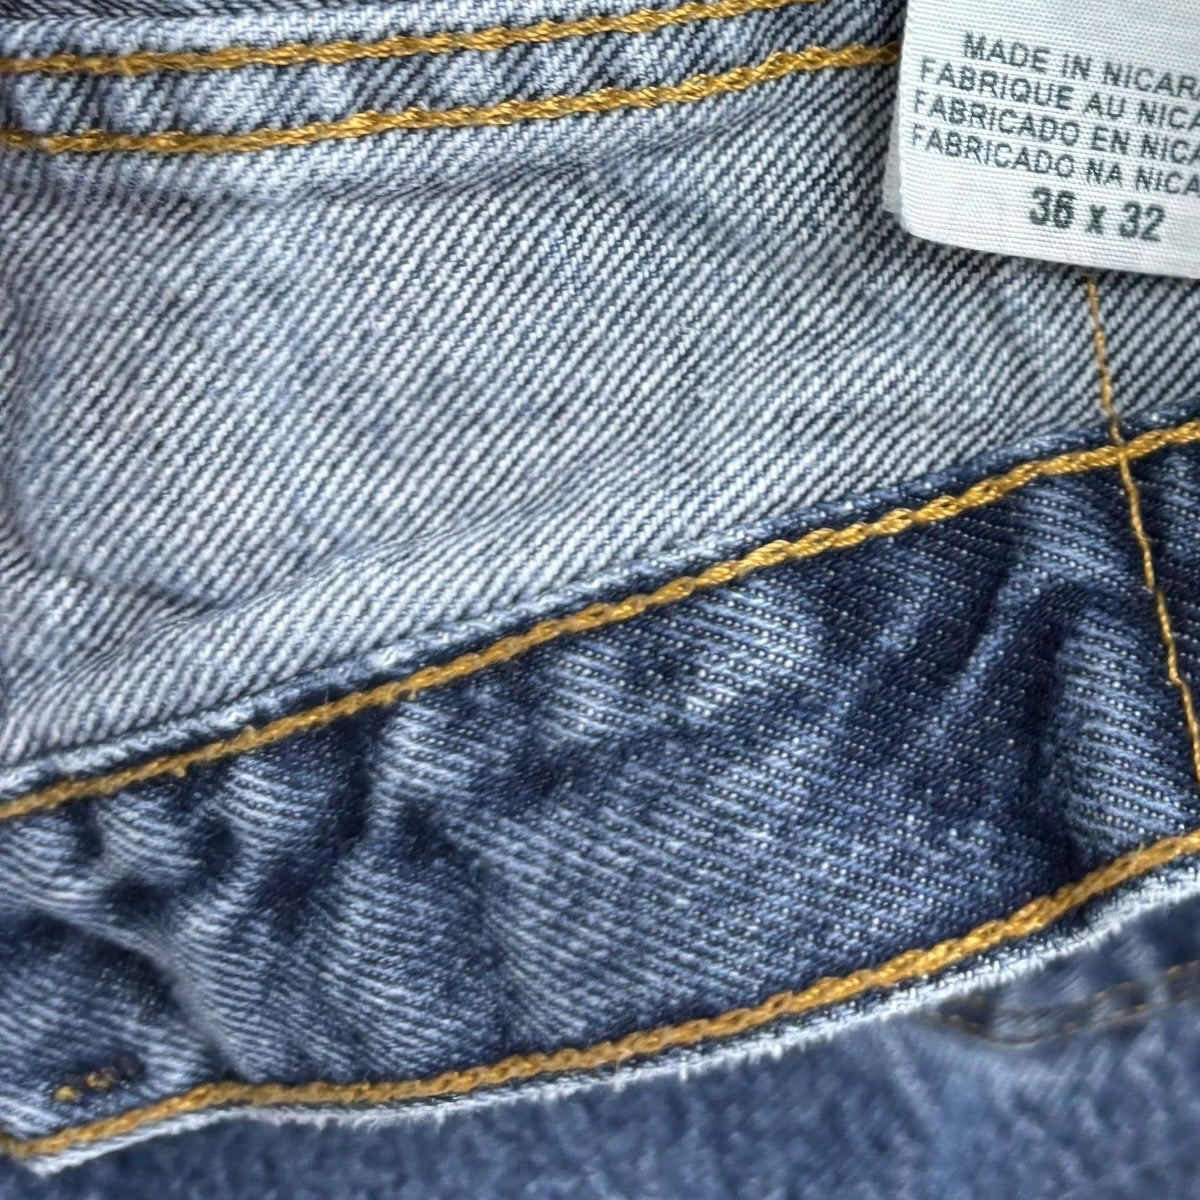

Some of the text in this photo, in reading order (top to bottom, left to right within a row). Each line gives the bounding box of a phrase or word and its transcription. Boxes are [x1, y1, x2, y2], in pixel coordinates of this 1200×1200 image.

[920, 54, 1075, 111] FABRIQUE
[1083, 91, 1127, 121] AU
[963, 31, 1051, 74] MADE
[1062, 52, 1092, 81] IN
[911, 121, 1075, 179] FABRICADO
[1085, 157, 1123, 188] NA
[914, 86, 1080, 147] FABRICADO
[1091, 125, 1130, 156] EN
[1028, 185, 1077, 230] 36
[1118, 200, 1166, 243] 32
